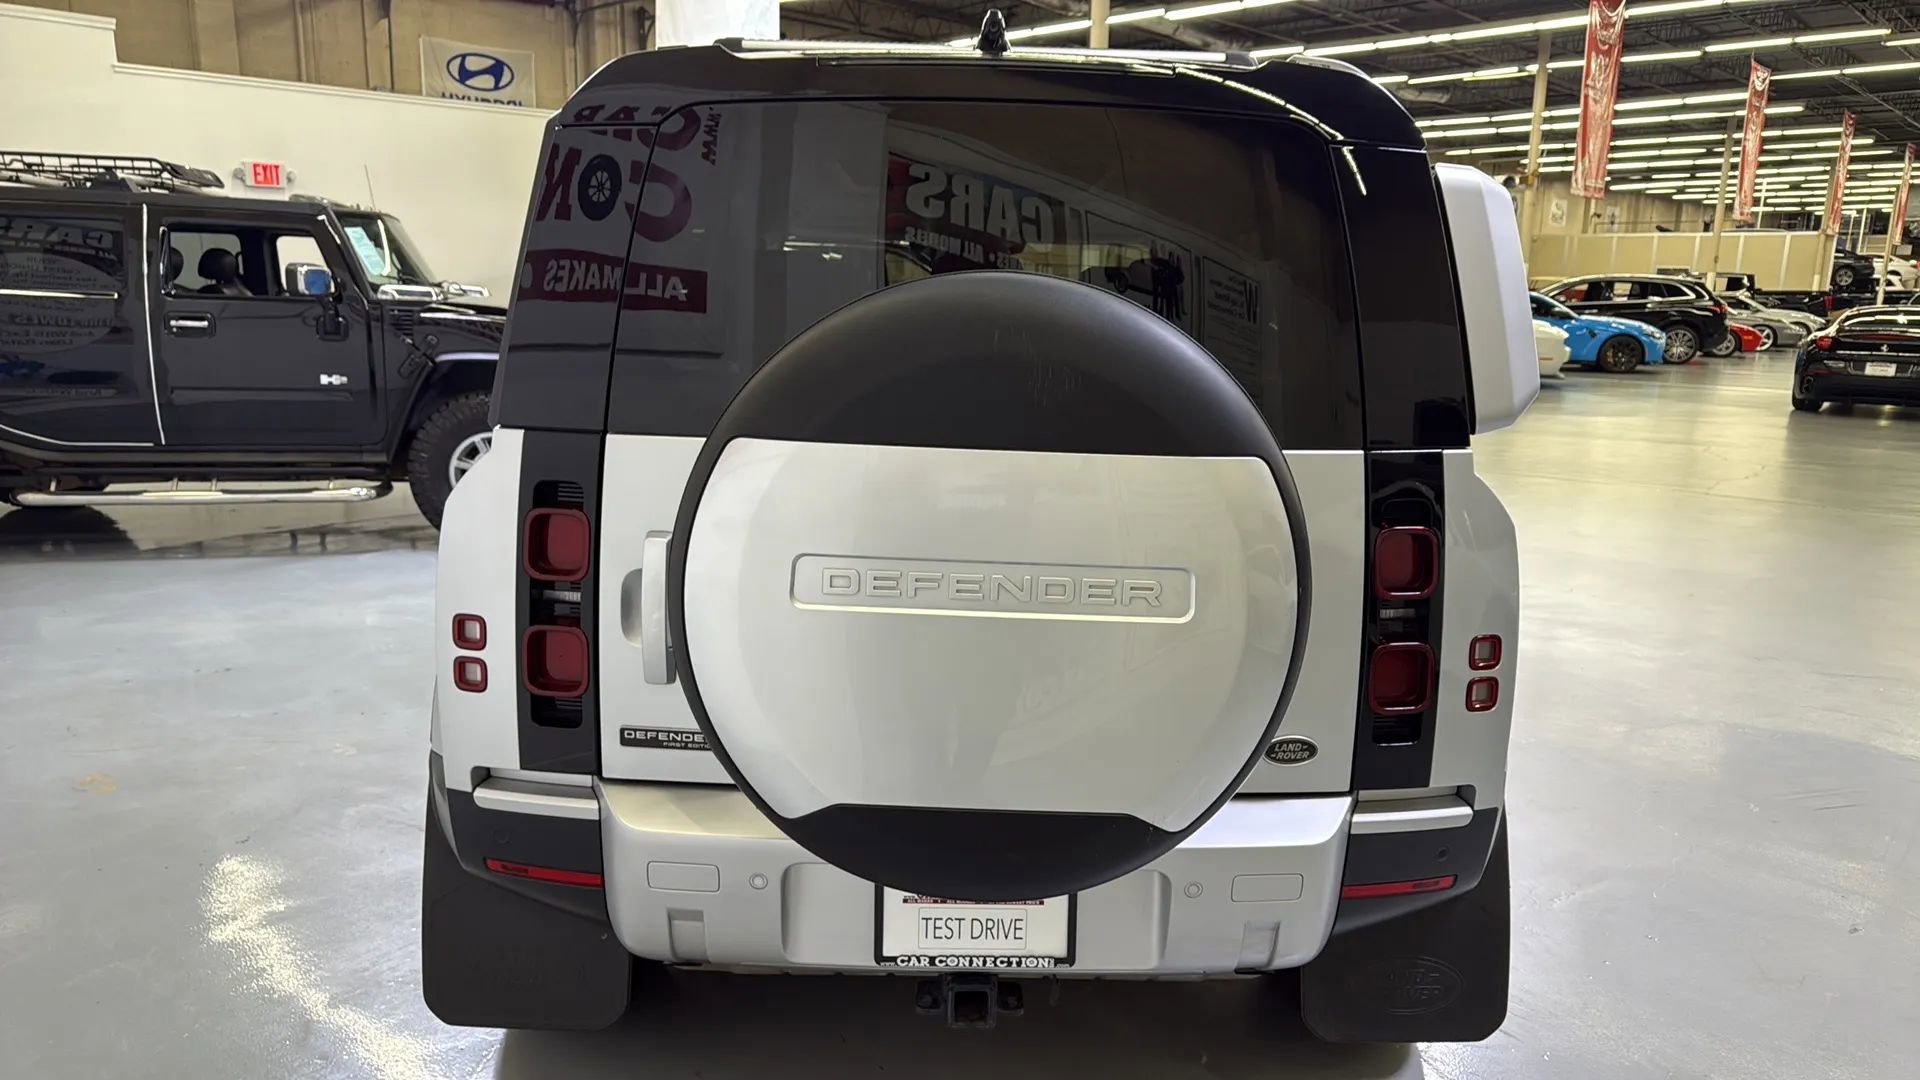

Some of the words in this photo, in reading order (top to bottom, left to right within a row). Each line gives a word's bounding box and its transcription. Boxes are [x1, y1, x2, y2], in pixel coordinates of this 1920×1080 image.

[253, 163, 280, 185] EXIT
[821, 567, 1163, 607] DEFENDER
[624, 730, 704, 742] DEFENDE
[921, 917, 965, 940] TEST
[970, 918, 1024, 940] DRIVE
[896, 956, 930, 968] CAR
